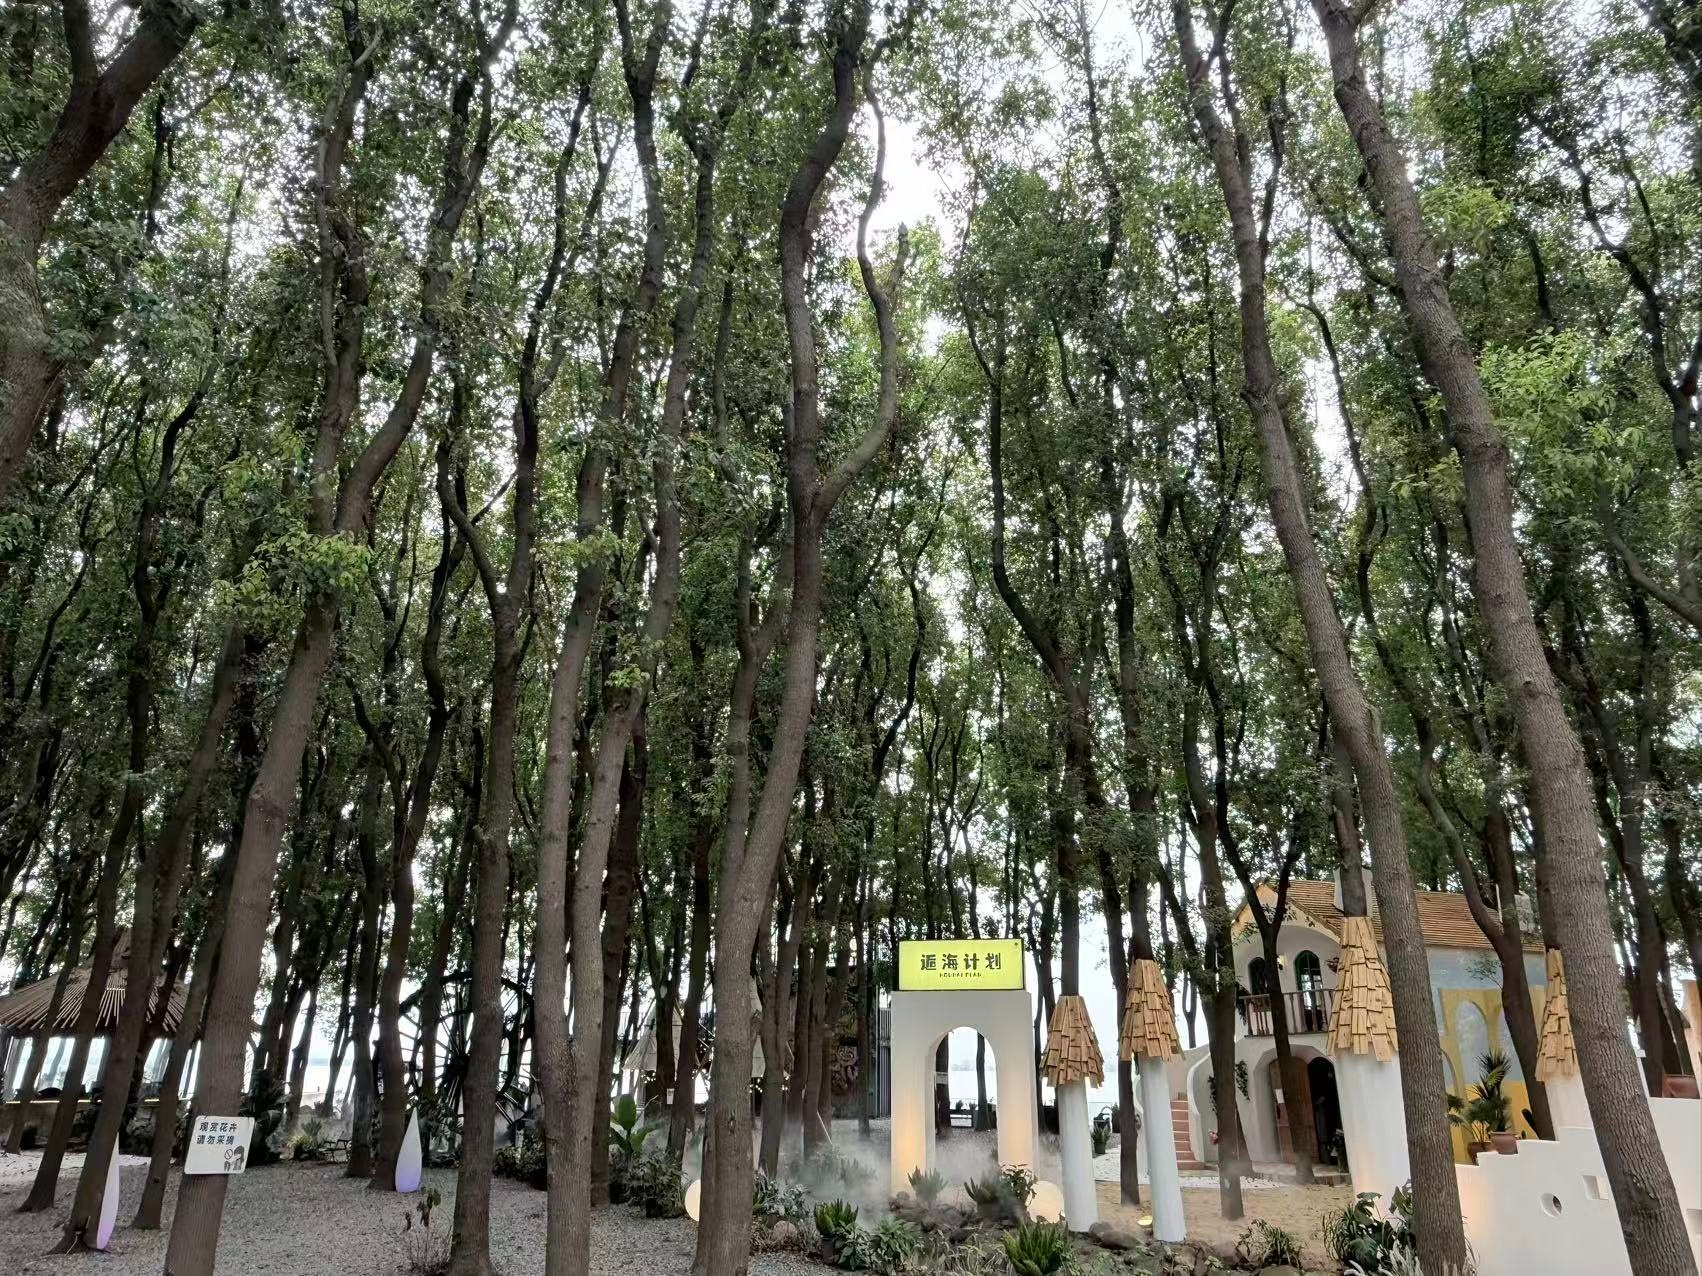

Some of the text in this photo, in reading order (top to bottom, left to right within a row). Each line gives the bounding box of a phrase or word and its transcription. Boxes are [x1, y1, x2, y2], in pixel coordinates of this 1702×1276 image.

[920, 952, 1001, 971] 逅海计划
[199, 1121, 237, 1133] 观赏花卉
[196, 1134, 235, 1146] 请勿采摘
